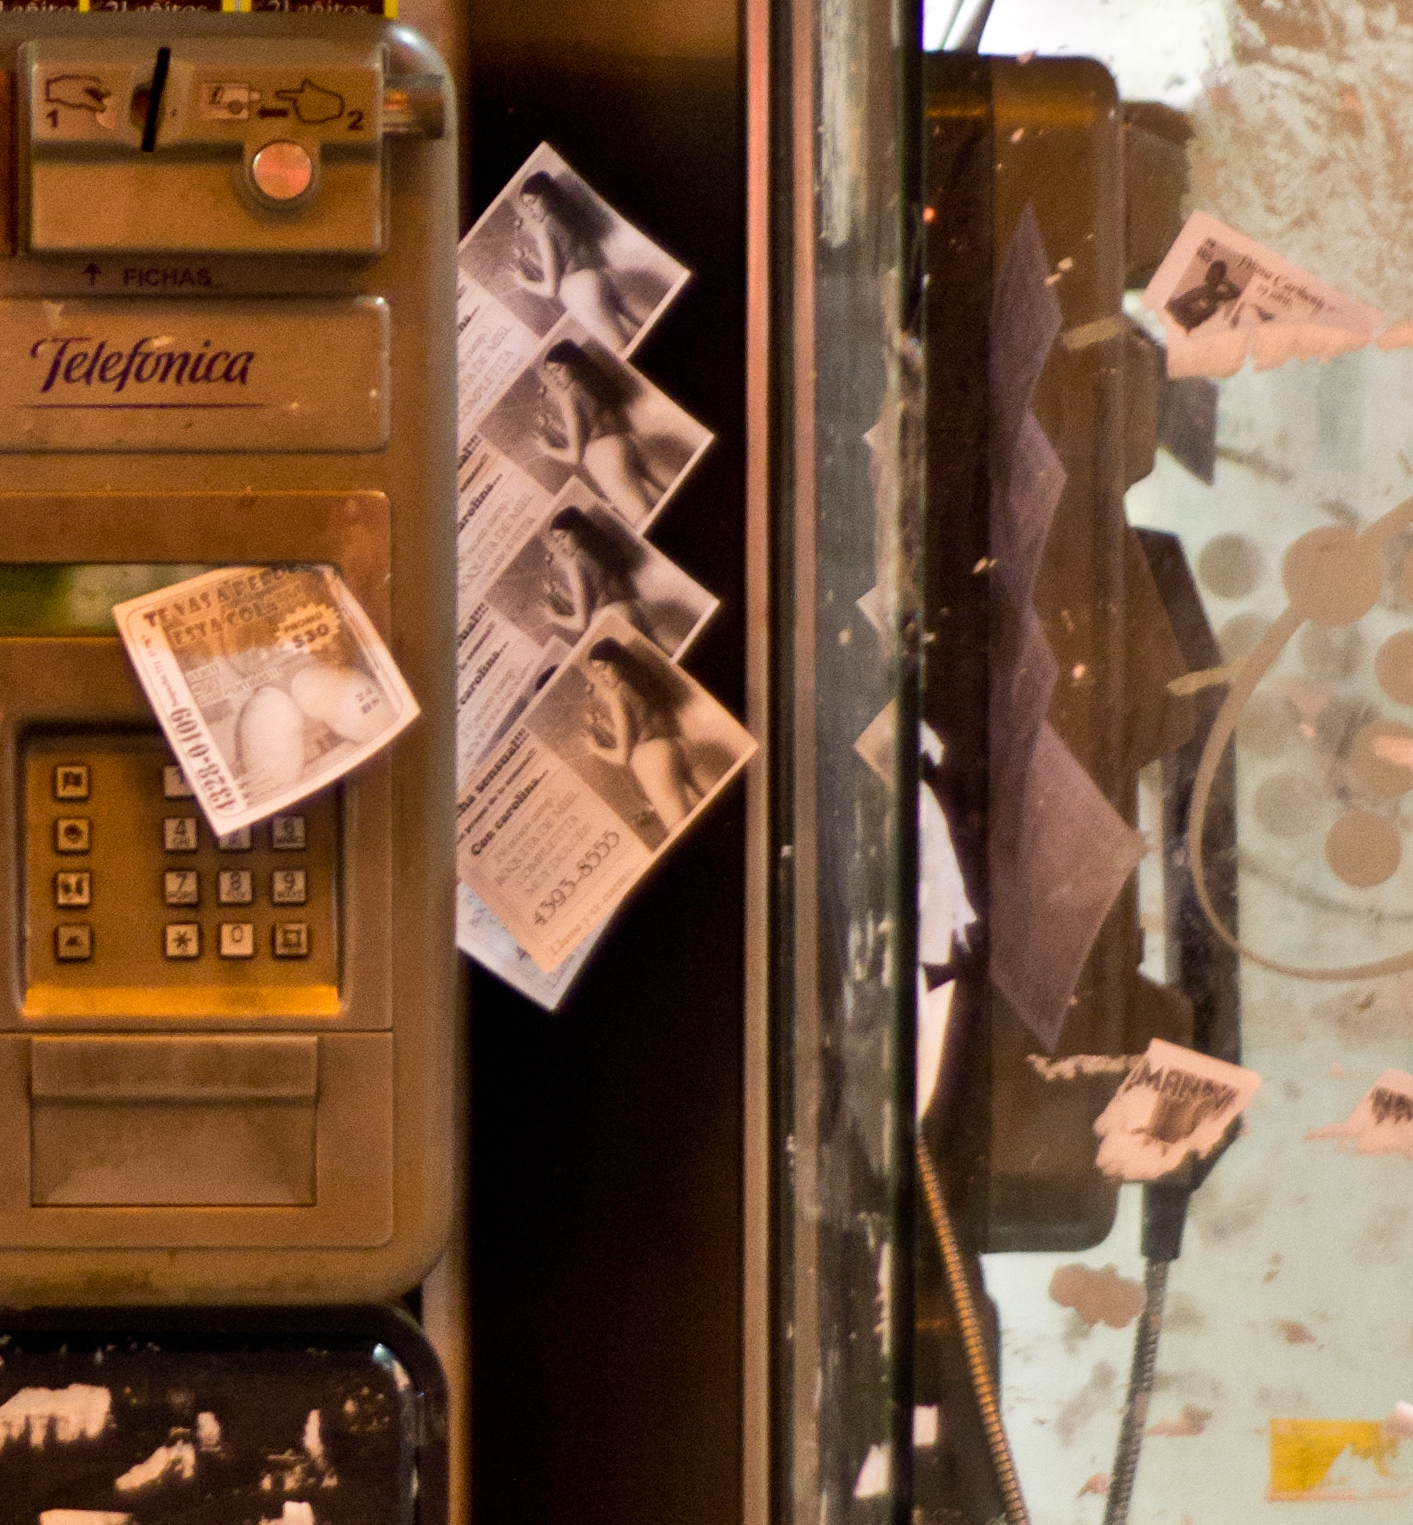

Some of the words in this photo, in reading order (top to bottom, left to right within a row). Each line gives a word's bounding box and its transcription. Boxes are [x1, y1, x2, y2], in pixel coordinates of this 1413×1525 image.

[47, 108, 58, 128] 1
[347, 111, 364, 130] 2
[123, 267, 212, 287] FICHAS
[142, 605, 174, 629] TE
[172, 591, 212, 618] VAS
[172, 615, 224, 647] ESTA
[168, 704, 237, 812] 4328-0109
[468, 826, 496, 857] Con
[283, 871, 295, 890] 9
[527, 825, 623, 929] 4393-8555
[230, 925, 243, 943] 0
